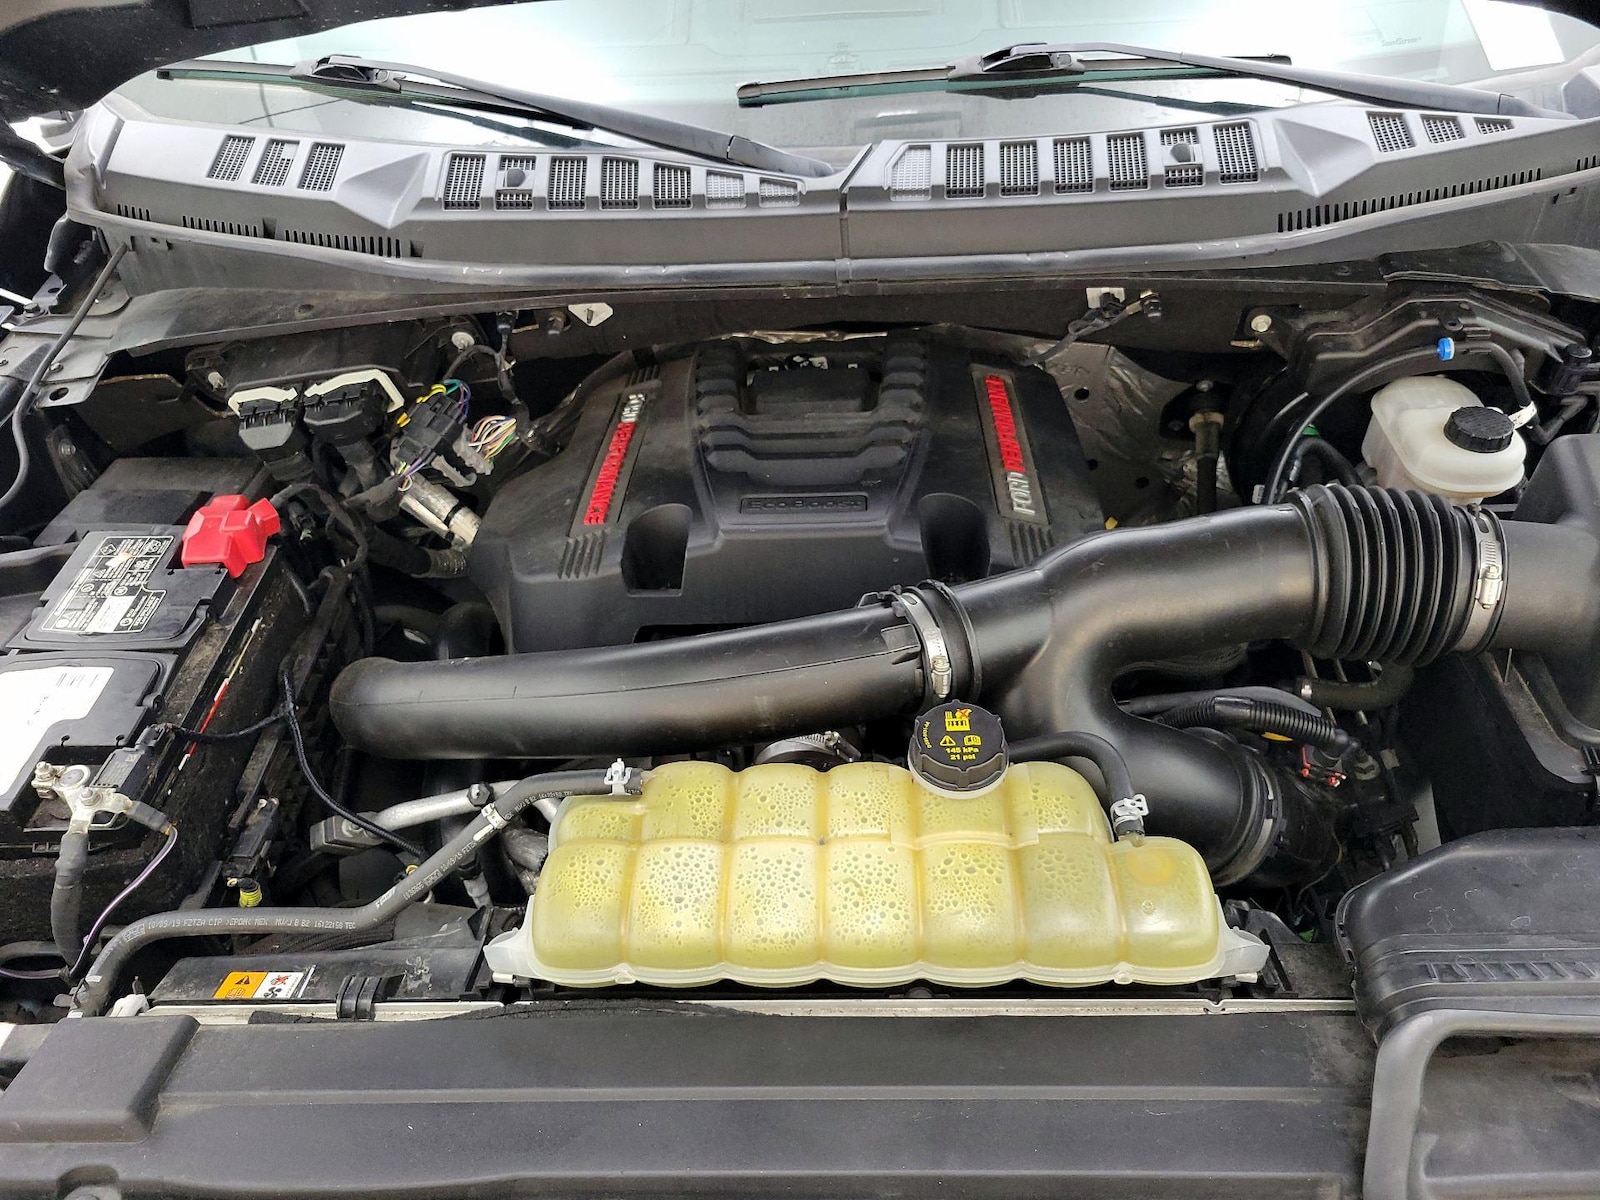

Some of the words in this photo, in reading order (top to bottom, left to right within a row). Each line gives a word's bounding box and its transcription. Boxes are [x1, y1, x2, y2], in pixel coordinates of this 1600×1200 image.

[1006, 471, 1036, 516] FORD
[747, 499, 863, 512] EcoBoost
[962, 746, 980, 754] kPa
